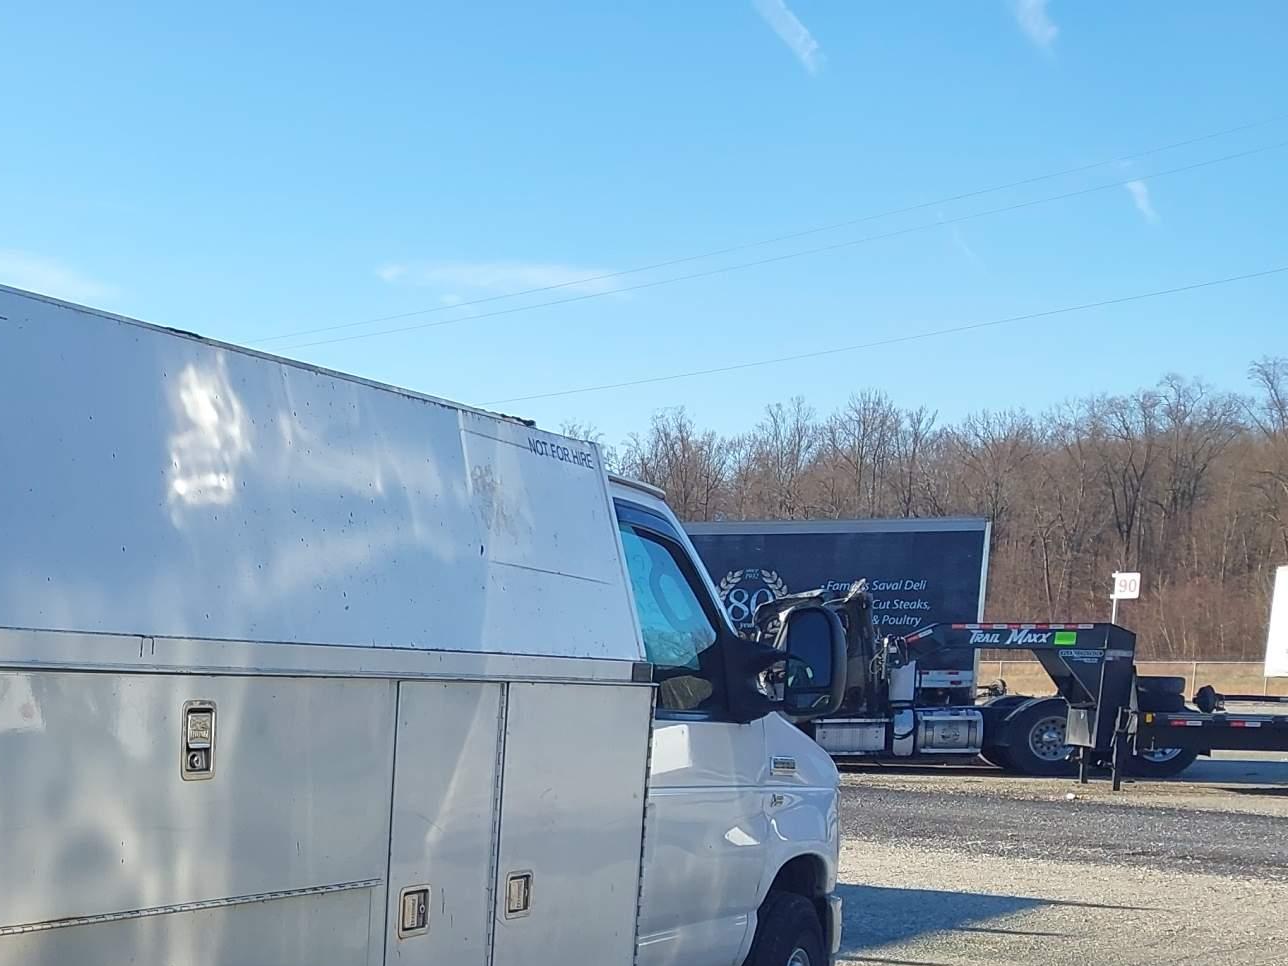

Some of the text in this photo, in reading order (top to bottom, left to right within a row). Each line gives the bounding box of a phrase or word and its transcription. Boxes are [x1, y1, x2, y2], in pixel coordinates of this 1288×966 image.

[528, 437, 594, 469] NOT FOR HIRE
[872, 580, 903, 591] Saval
[904, 580, 927, 591] Deli
[1119, 578, 1137, 593] 90
[872, 598, 930, 611] Cut Steaks,
[872, 614, 922, 628] & Poultry
